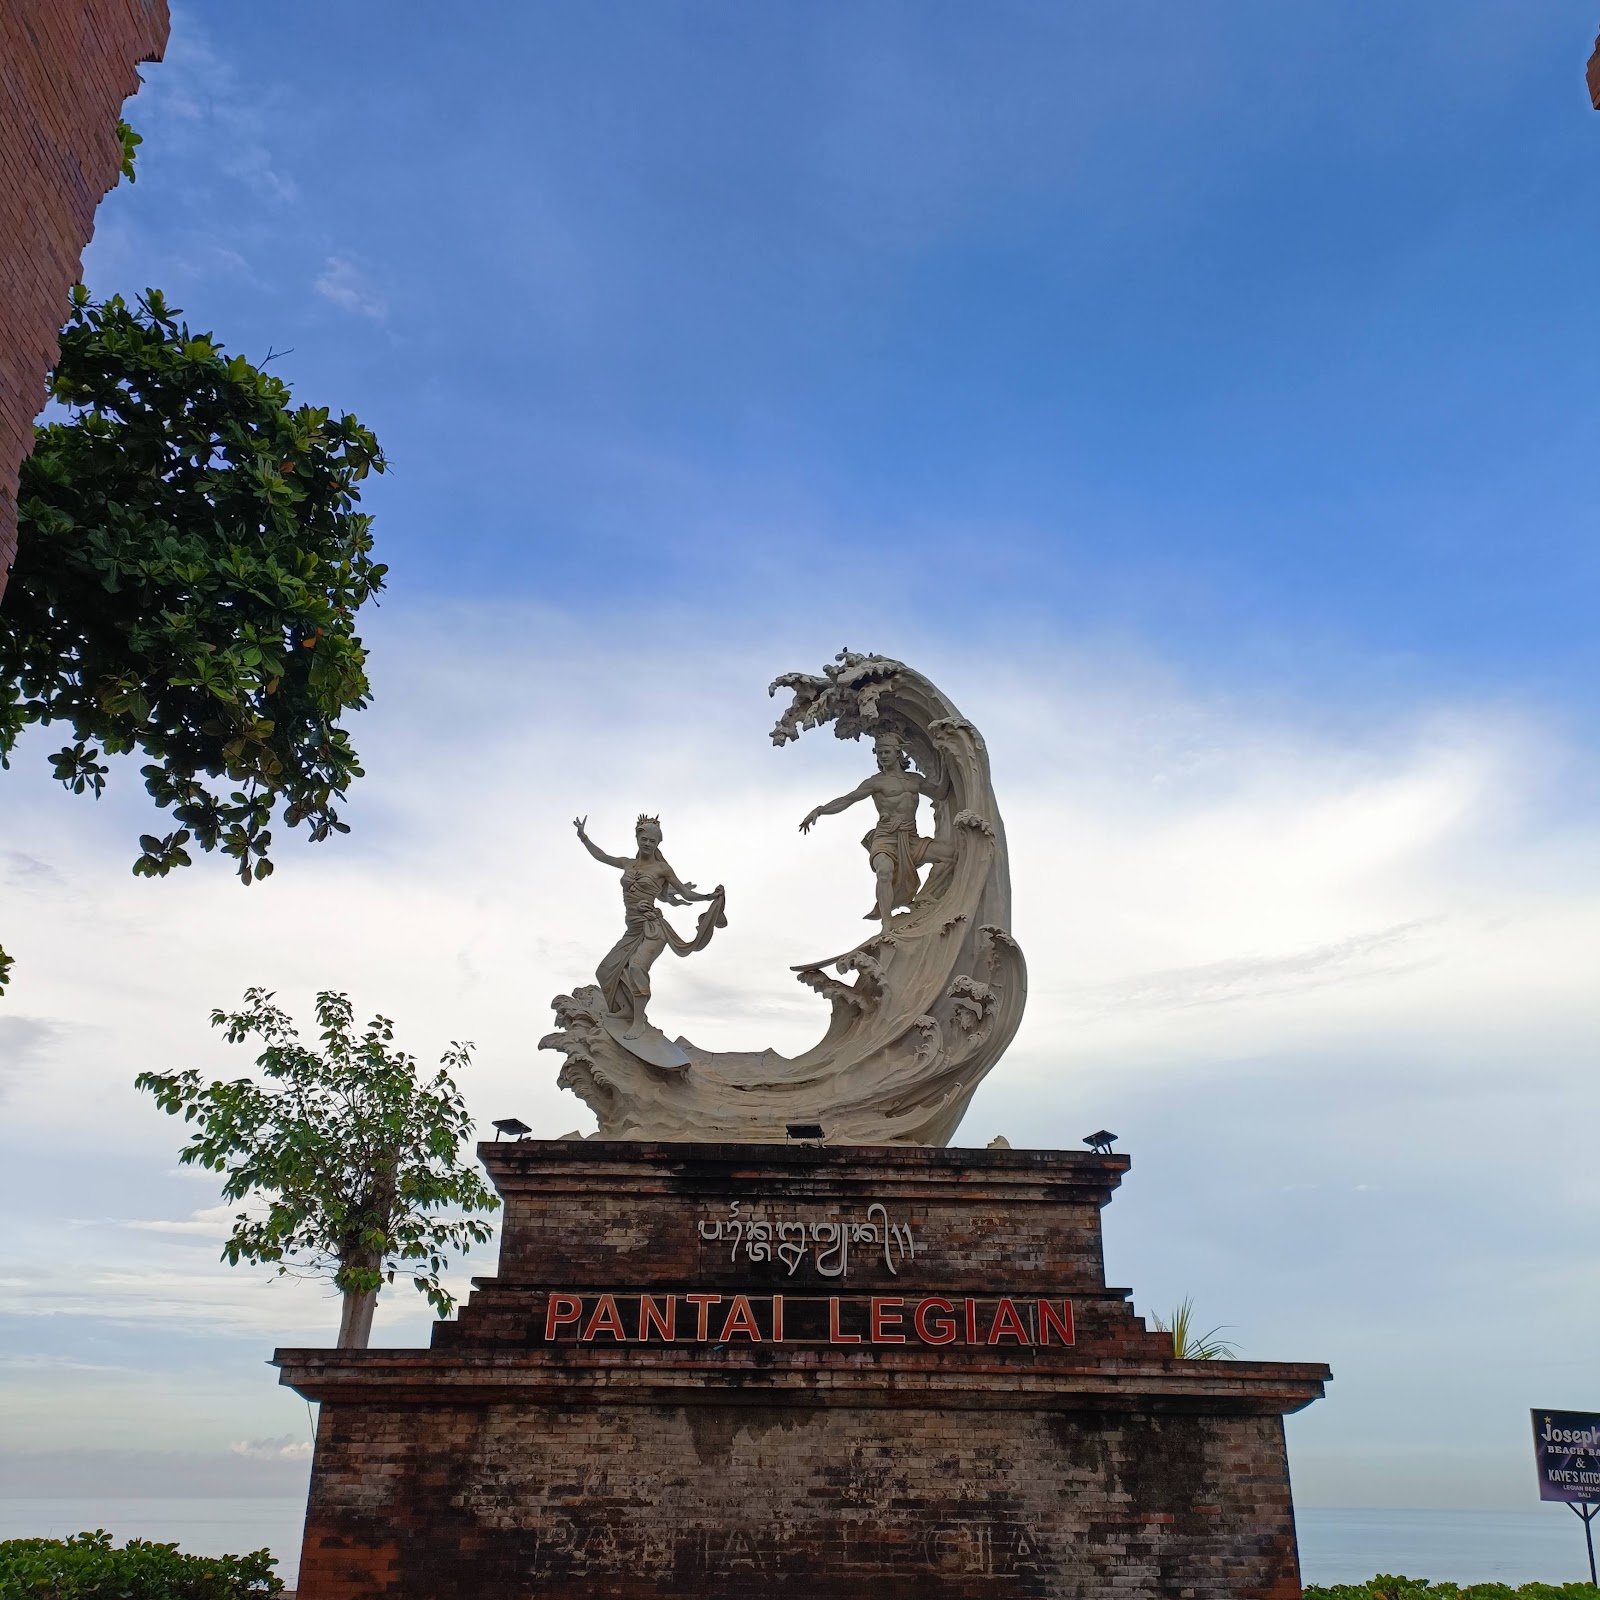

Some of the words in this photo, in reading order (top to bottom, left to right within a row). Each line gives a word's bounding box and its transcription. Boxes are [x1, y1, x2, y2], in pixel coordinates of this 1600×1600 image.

[544, 1293, 784, 1342] PANTAI
[829, 1296, 1077, 1346] LEGIAN
[1547, 1446, 1585, 1456] BEACH
[1576, 1458, 1586, 1469] &
[1548, 1469, 1579, 1483] KAYE'S
[1579, 1471, 1600, 1485] KITC
